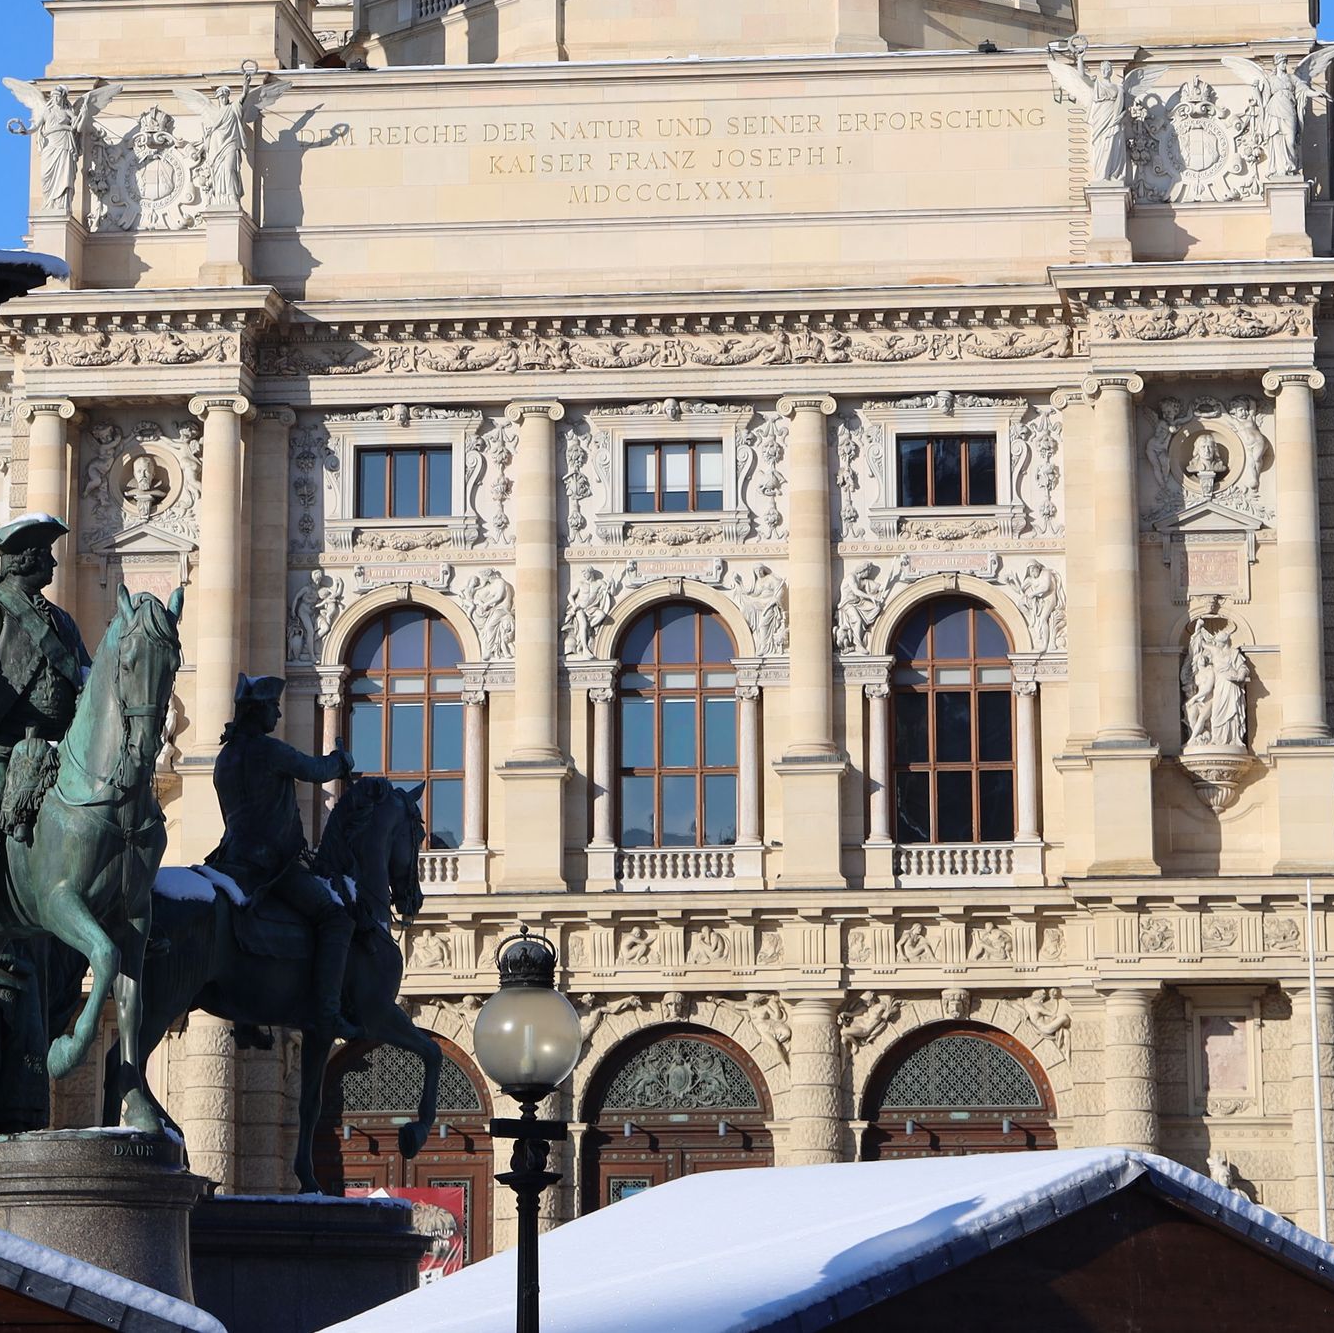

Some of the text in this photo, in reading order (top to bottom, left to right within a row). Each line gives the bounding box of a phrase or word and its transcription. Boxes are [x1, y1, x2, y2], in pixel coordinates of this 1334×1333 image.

[299, 108, 1046, 146] DEM REICHE DER NATUR UND SEINER ERFORSCHUNG
[489, 146, 854, 174] KAISER FRANZ JOSEPH I.
[567, 180, 774, 204] MDCCCLXXXI.
[113, 1145, 154, 1156] DAUN
